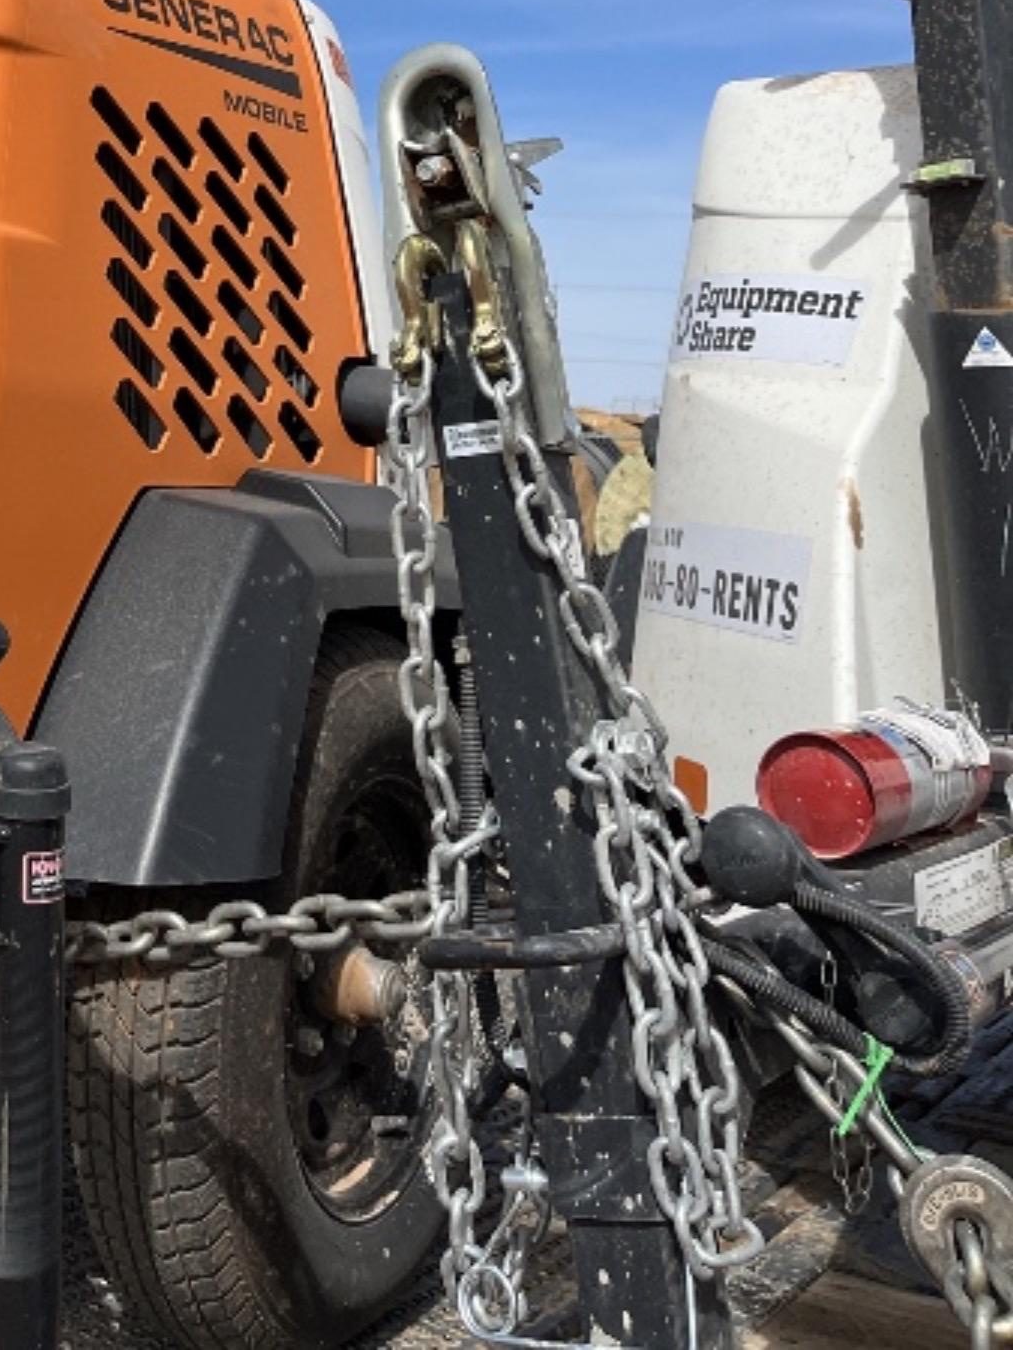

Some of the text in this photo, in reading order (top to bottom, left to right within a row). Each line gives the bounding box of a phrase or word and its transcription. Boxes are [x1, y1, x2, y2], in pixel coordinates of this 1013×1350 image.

[223, 88, 309, 133] MOBILE
[695, 277, 865, 320] Equipment
[688, 320, 756, 352] Share
